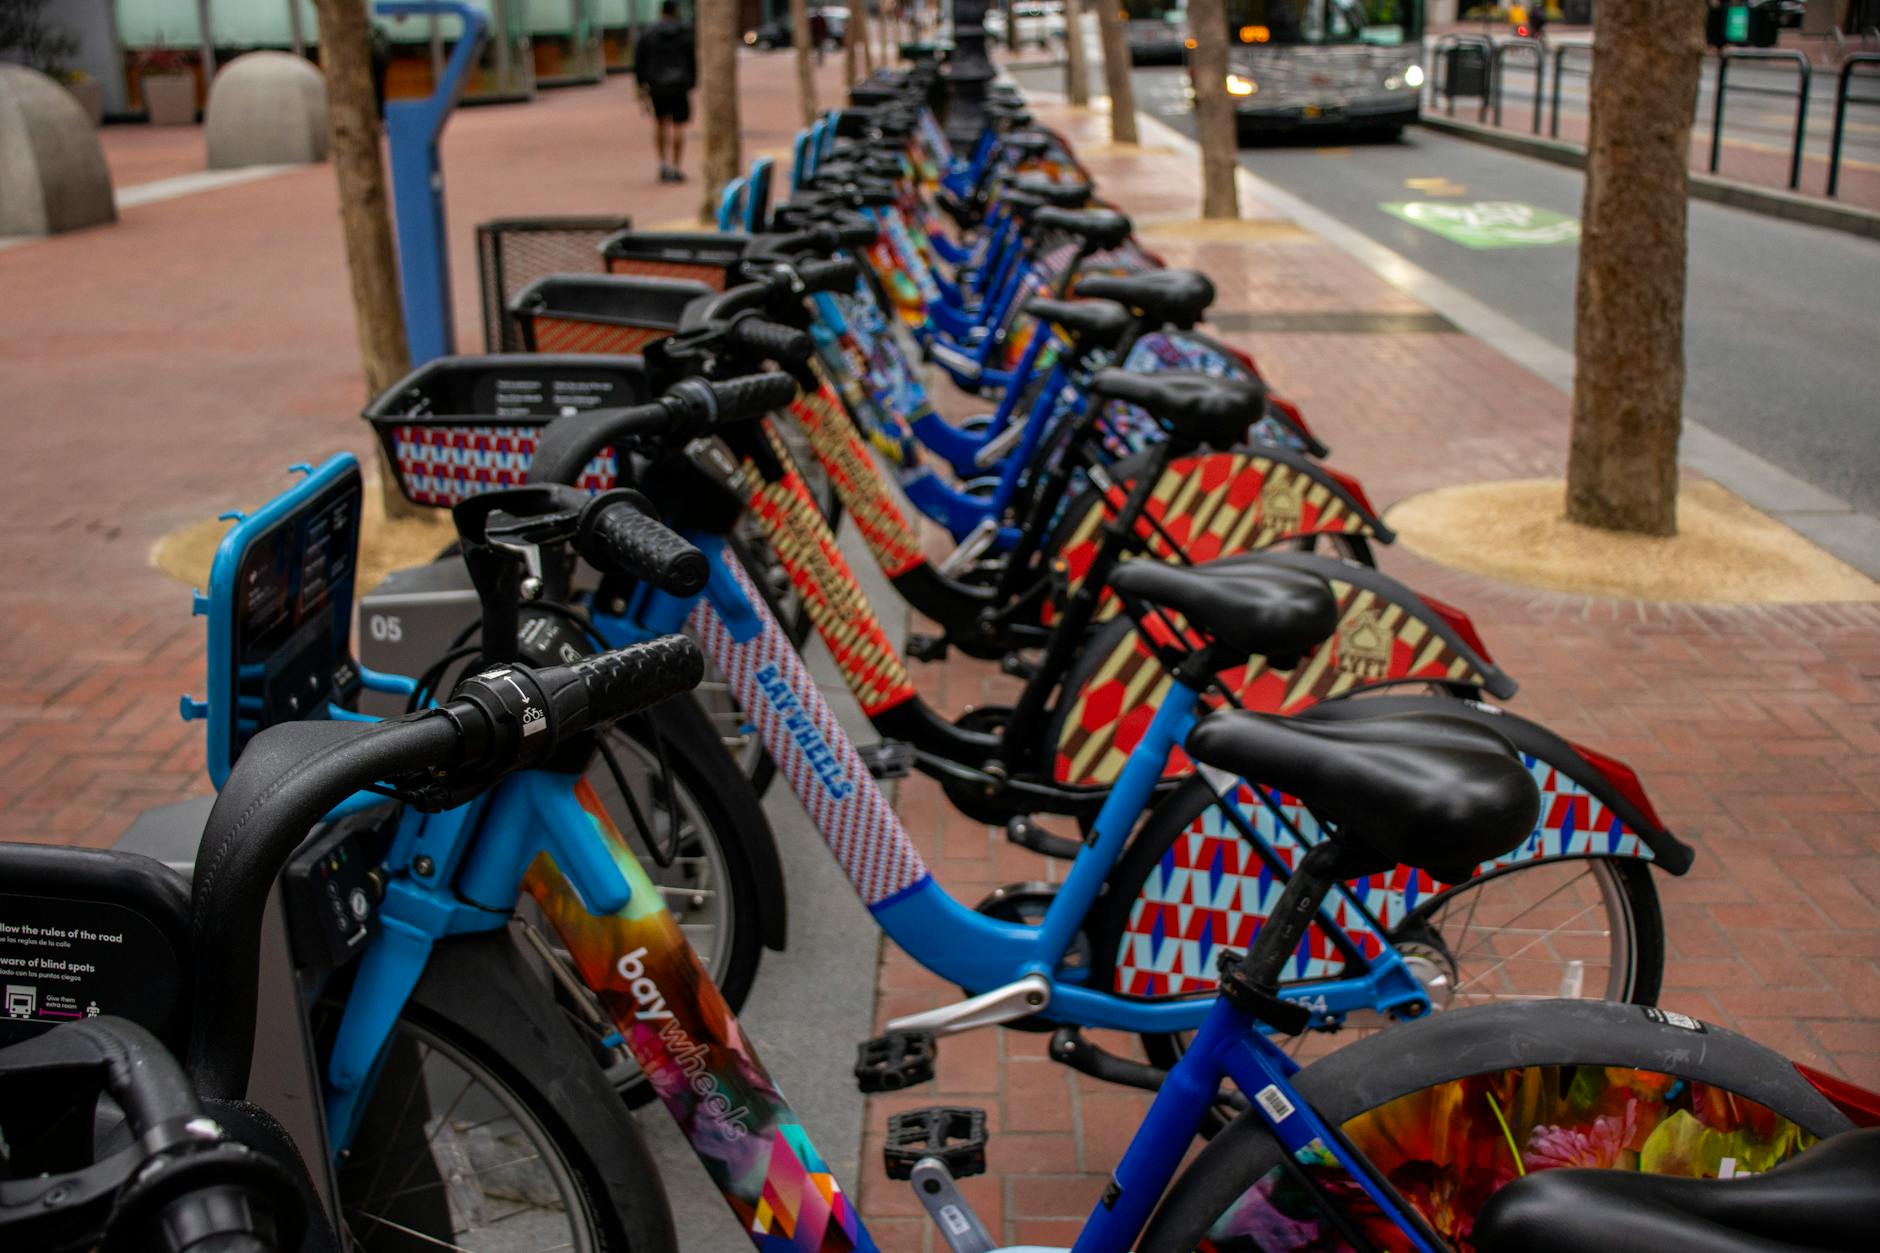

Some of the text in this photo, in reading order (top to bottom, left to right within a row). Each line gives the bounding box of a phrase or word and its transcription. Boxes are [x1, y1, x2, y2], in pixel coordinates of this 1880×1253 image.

[370, 614, 403, 643] 05
[21, 925, 39, 935] the
[40, 927, 66, 937] rules
[67, 929, 79, 939] of
[80, 930, 97, 940] the
[99, 933, 122, 943] road
[27, 958, 40, 967] of
[41, 958, 66, 969] blind
[68, 963, 95, 973] spots
